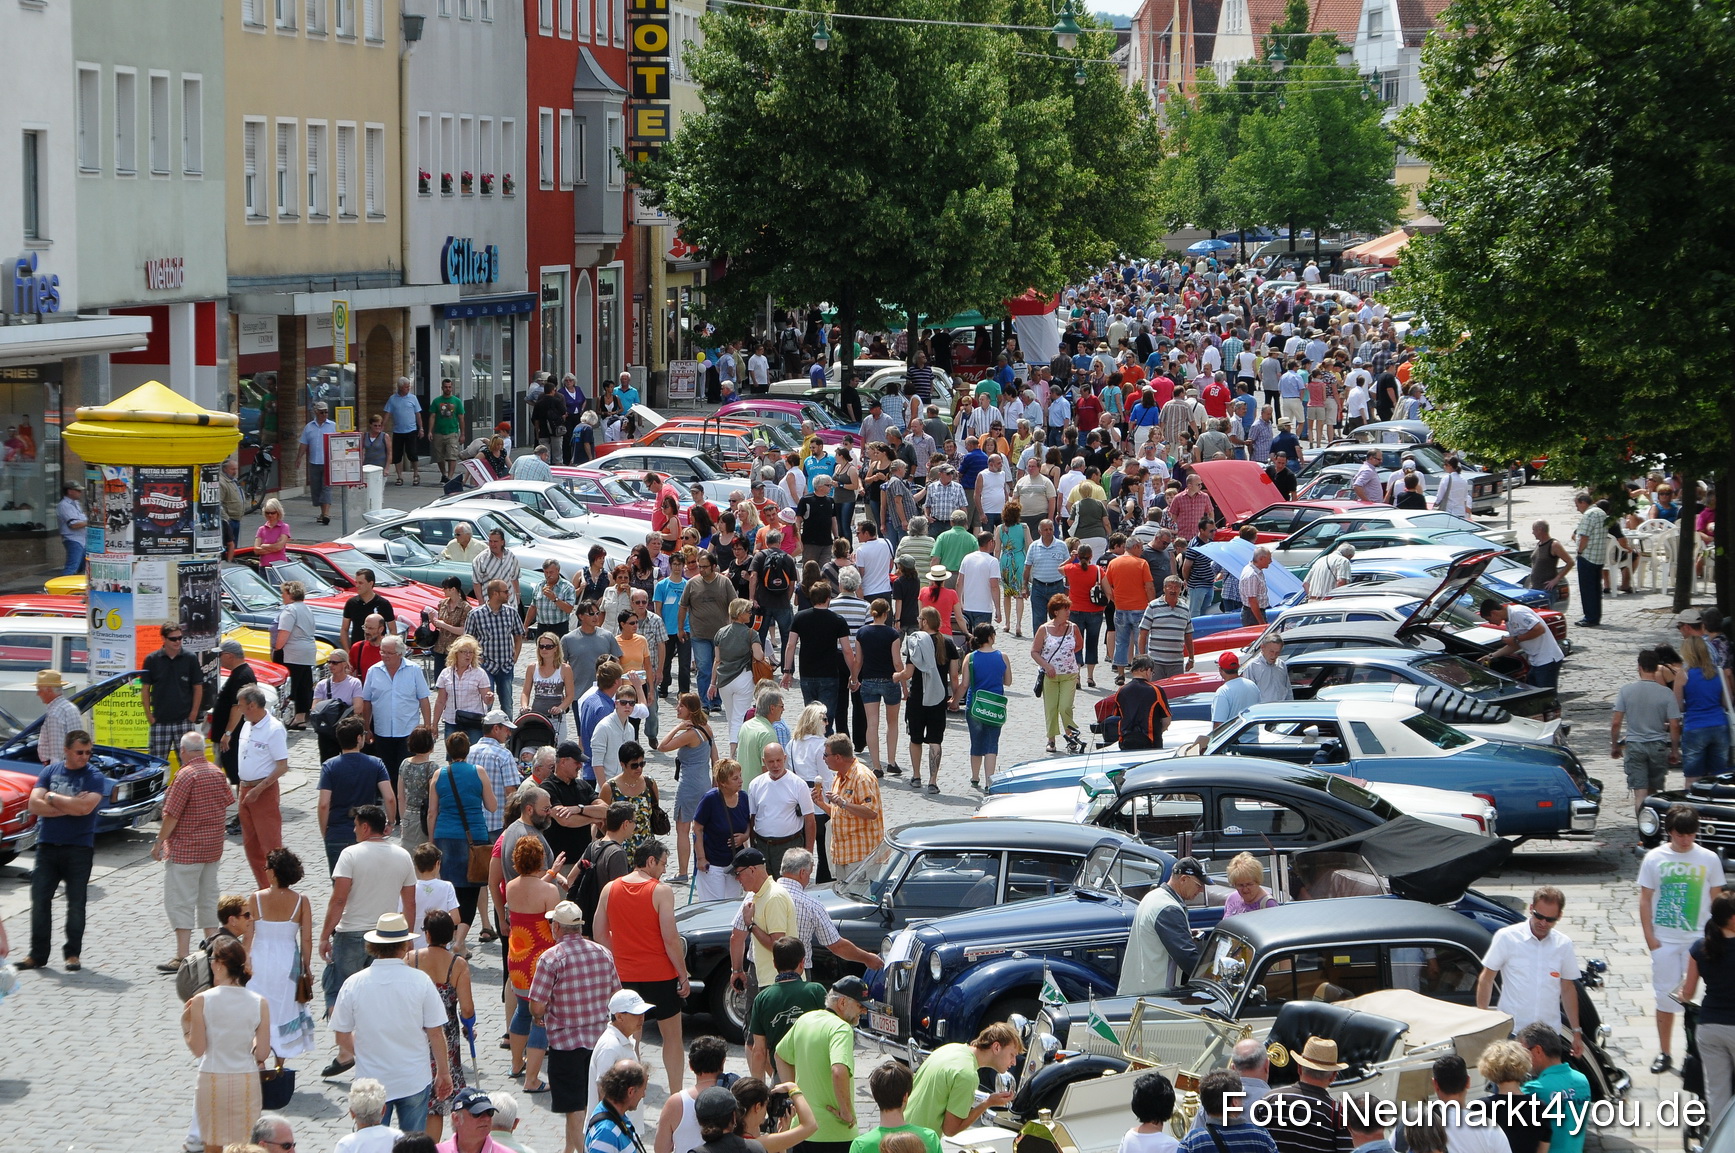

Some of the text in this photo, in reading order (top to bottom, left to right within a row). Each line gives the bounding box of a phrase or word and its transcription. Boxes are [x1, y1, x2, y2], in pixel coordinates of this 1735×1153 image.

[12, 251, 60, 314] fries
[146, 257, 184, 290] Weltbild
[140, 497, 188, 509] ALTSTADTFEST
[975, 707, 998, 719] adidas
